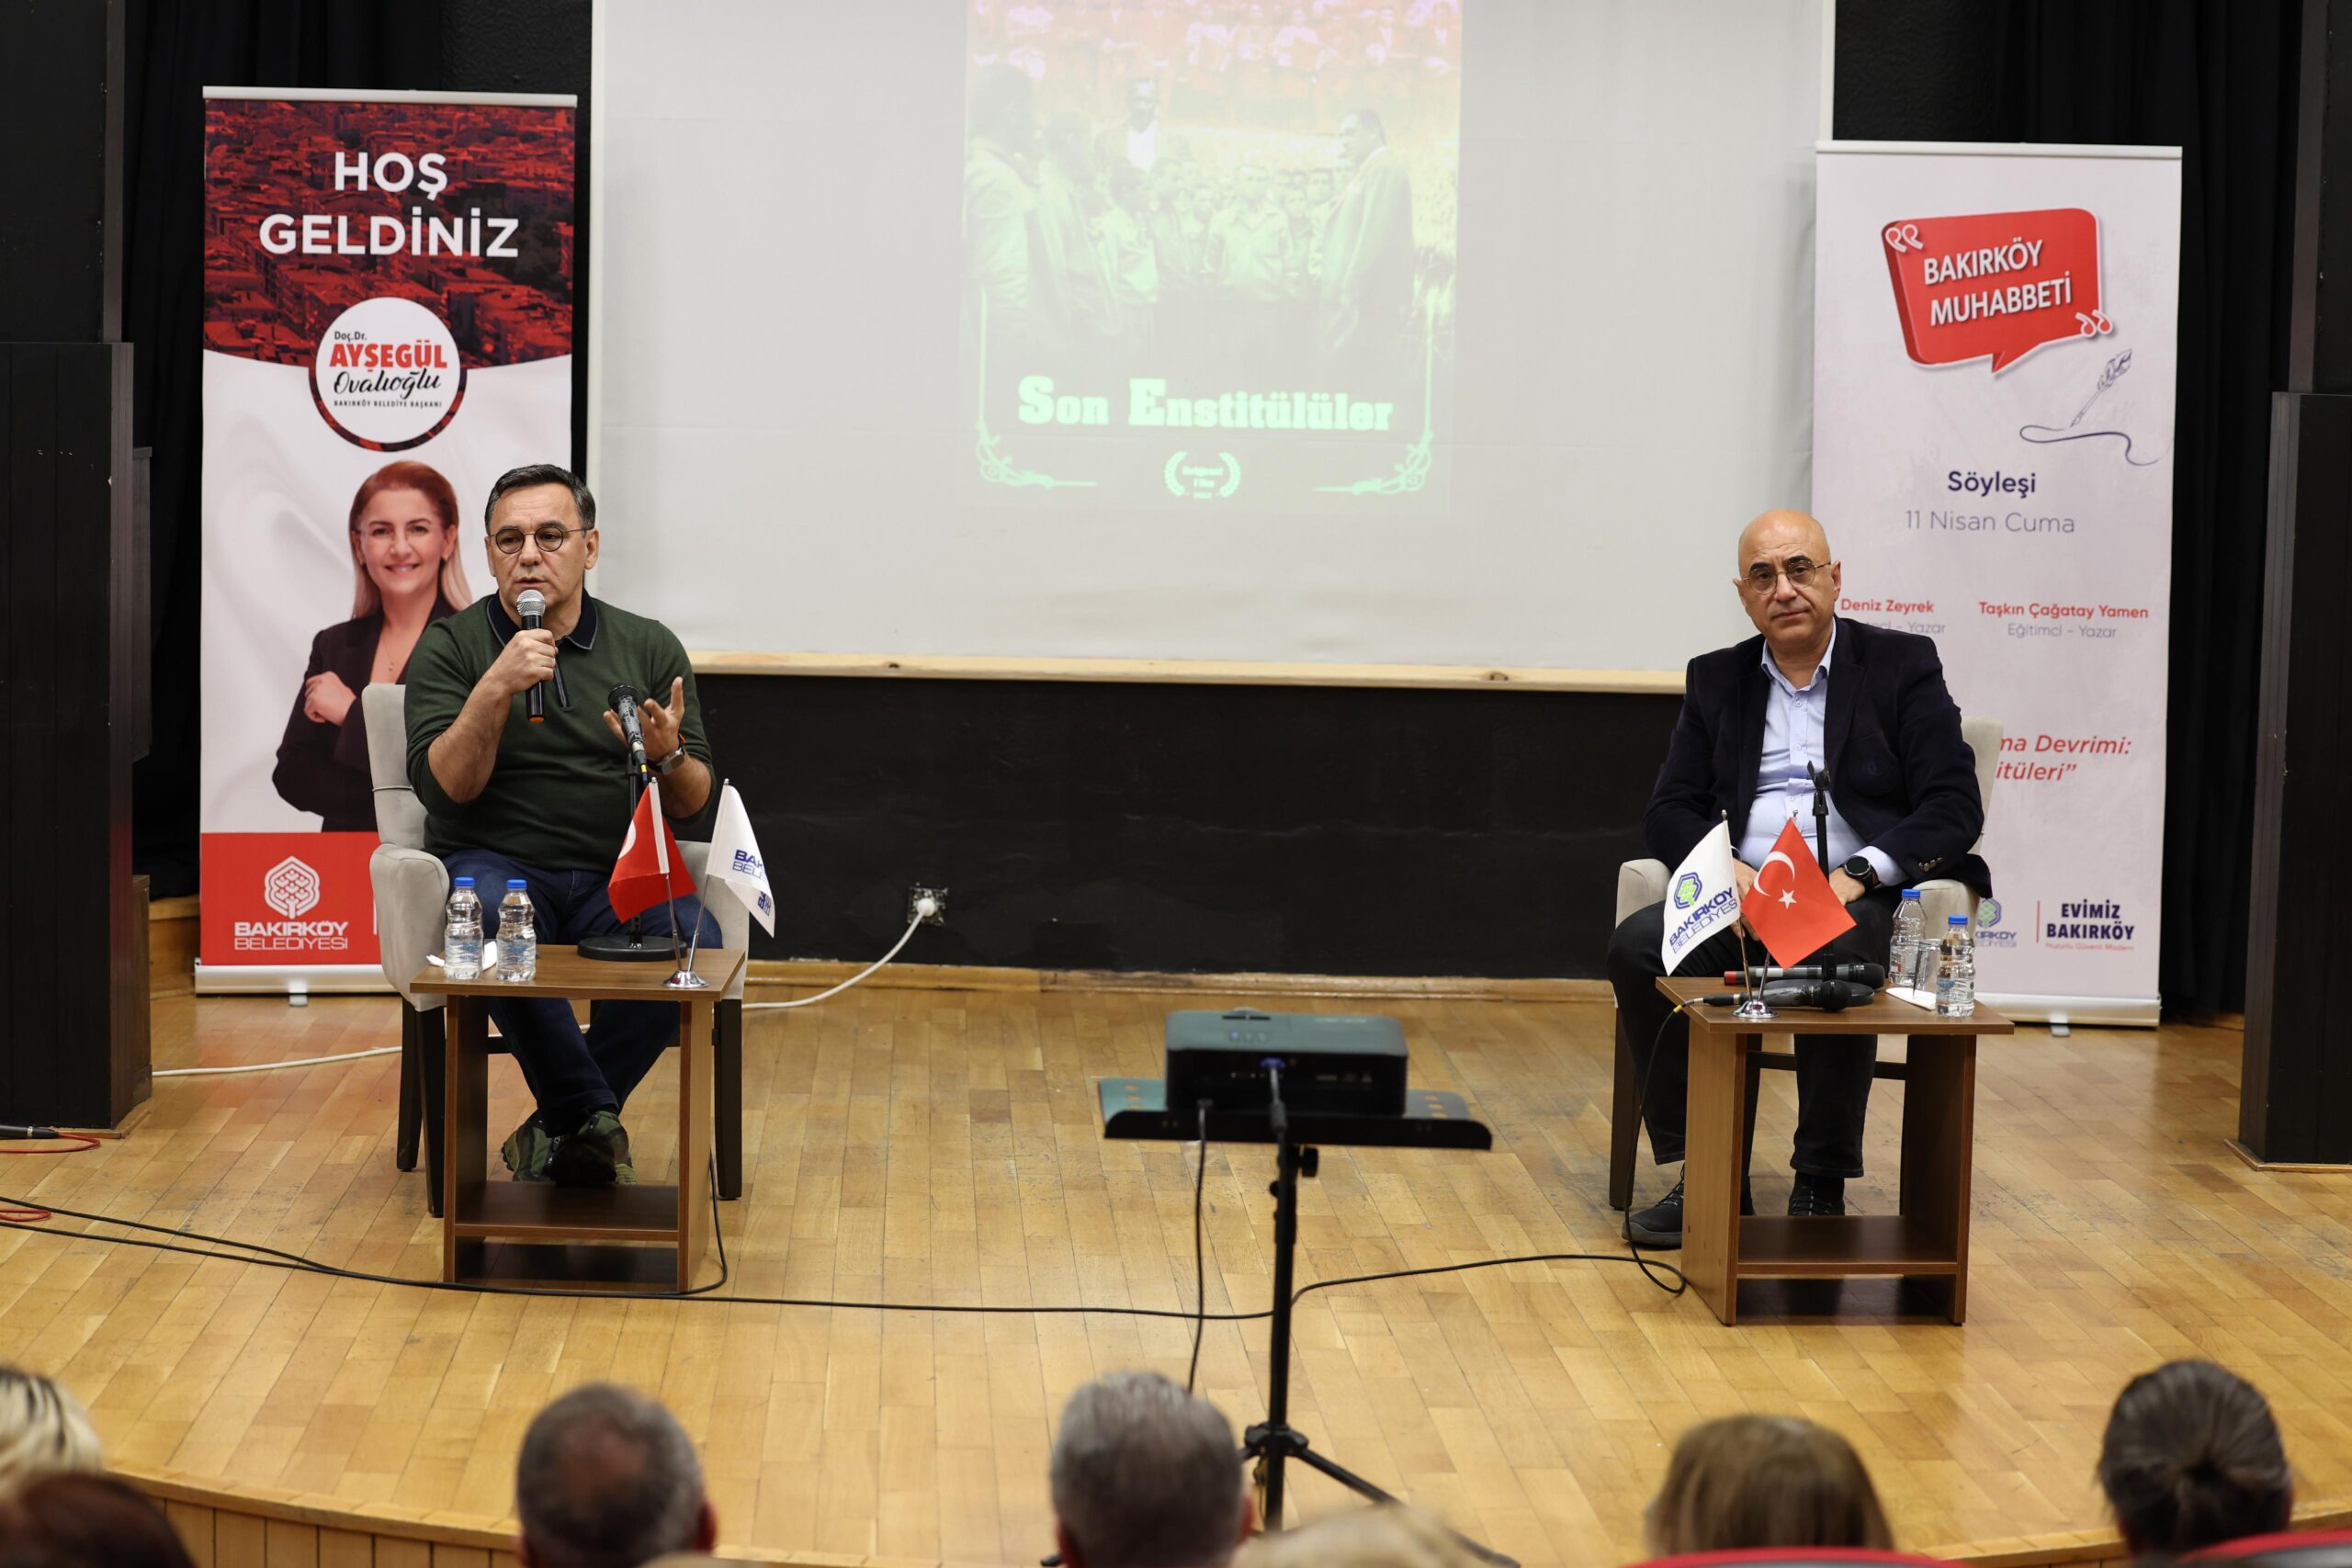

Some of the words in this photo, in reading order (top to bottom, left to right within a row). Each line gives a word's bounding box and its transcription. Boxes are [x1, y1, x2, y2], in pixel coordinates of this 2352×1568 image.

[334, 151, 448, 201] HOŞ
[259, 207, 520, 258] GELDİNİZ
[1923, 236, 2044, 286] BAKIRKÖY
[1930, 271, 2073, 326] MUHABBETİ
[329, 339, 448, 373] AYŞEGÜL
[334, 367, 442, 400] Ovalıoğlu
[334, 399, 371, 408] BAKIRKÖY
[1018, 375, 1109, 425] Son
[1128, 378, 1394, 432] Enstitülüler
[1947, 470, 2037, 499] Söyleşi
[1905, 510, 1922, 529] 11
[1930, 511, 1997, 532] Nisan
[2004, 513, 2076, 534] Cuma
[1840, 599, 1883, 613] Deniz
[1885, 600, 1935, 615] Zeyrek
[1979, 602, 2024, 618] Taşkın
[2028, 603, 2095, 620] Çağatay
[2098, 606, 2150, 619] Yamen
[1908, 622, 1947, 635] Yazar
[2007, 623, 2064, 638] Eğitimci
[2078, 626, 2118, 638] Yazar
[2034, 734, 2132, 755] Devrimi:
[1996, 761, 2078, 781] itüleri”
[2061, 898, 2121, 919] EVİMİZ
[2046, 920, 2135, 941] BAKIRKÖY
